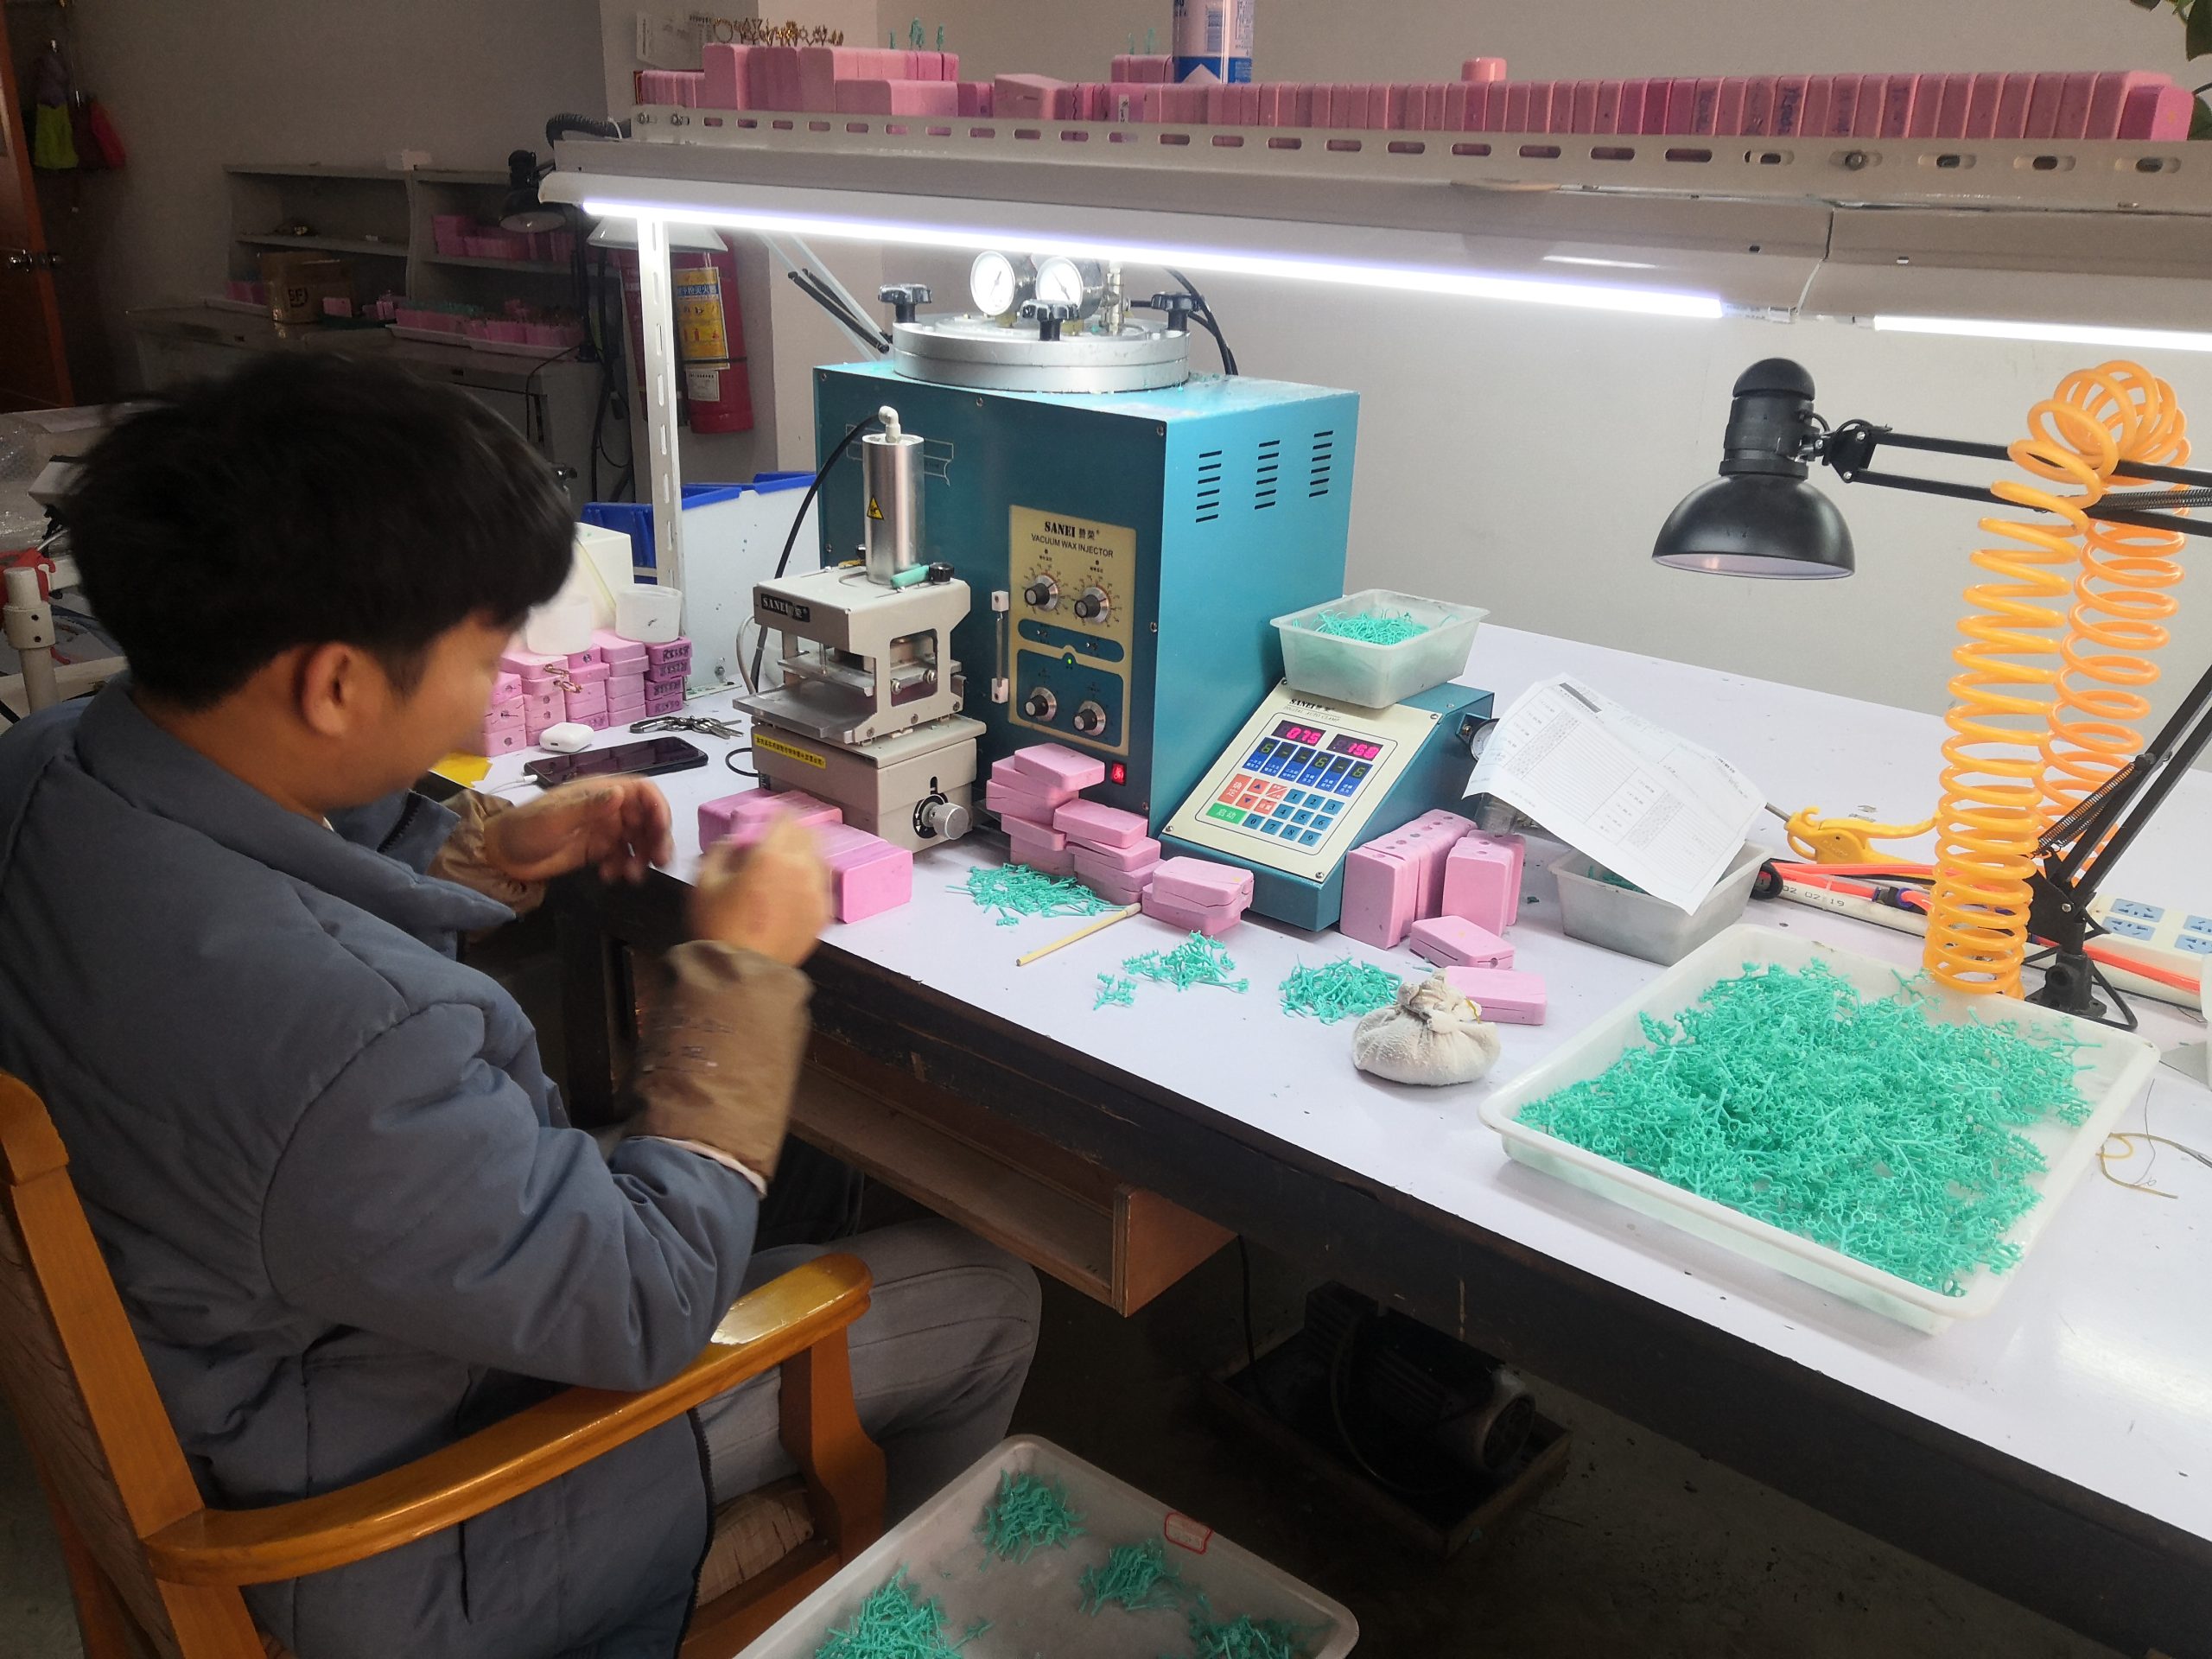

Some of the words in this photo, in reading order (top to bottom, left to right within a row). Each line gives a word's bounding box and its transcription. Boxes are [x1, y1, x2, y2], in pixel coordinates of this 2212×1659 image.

[1045, 521, 1076, 537] SANEI
[1032, 533, 1060, 547] VACUUM
[1062, 540, 1077, 550] WAX
[1078, 543, 1114, 558] INJECTOR
[1289, 698, 1315, 709] SANEI
[1217, 809, 1236, 820] 启动
